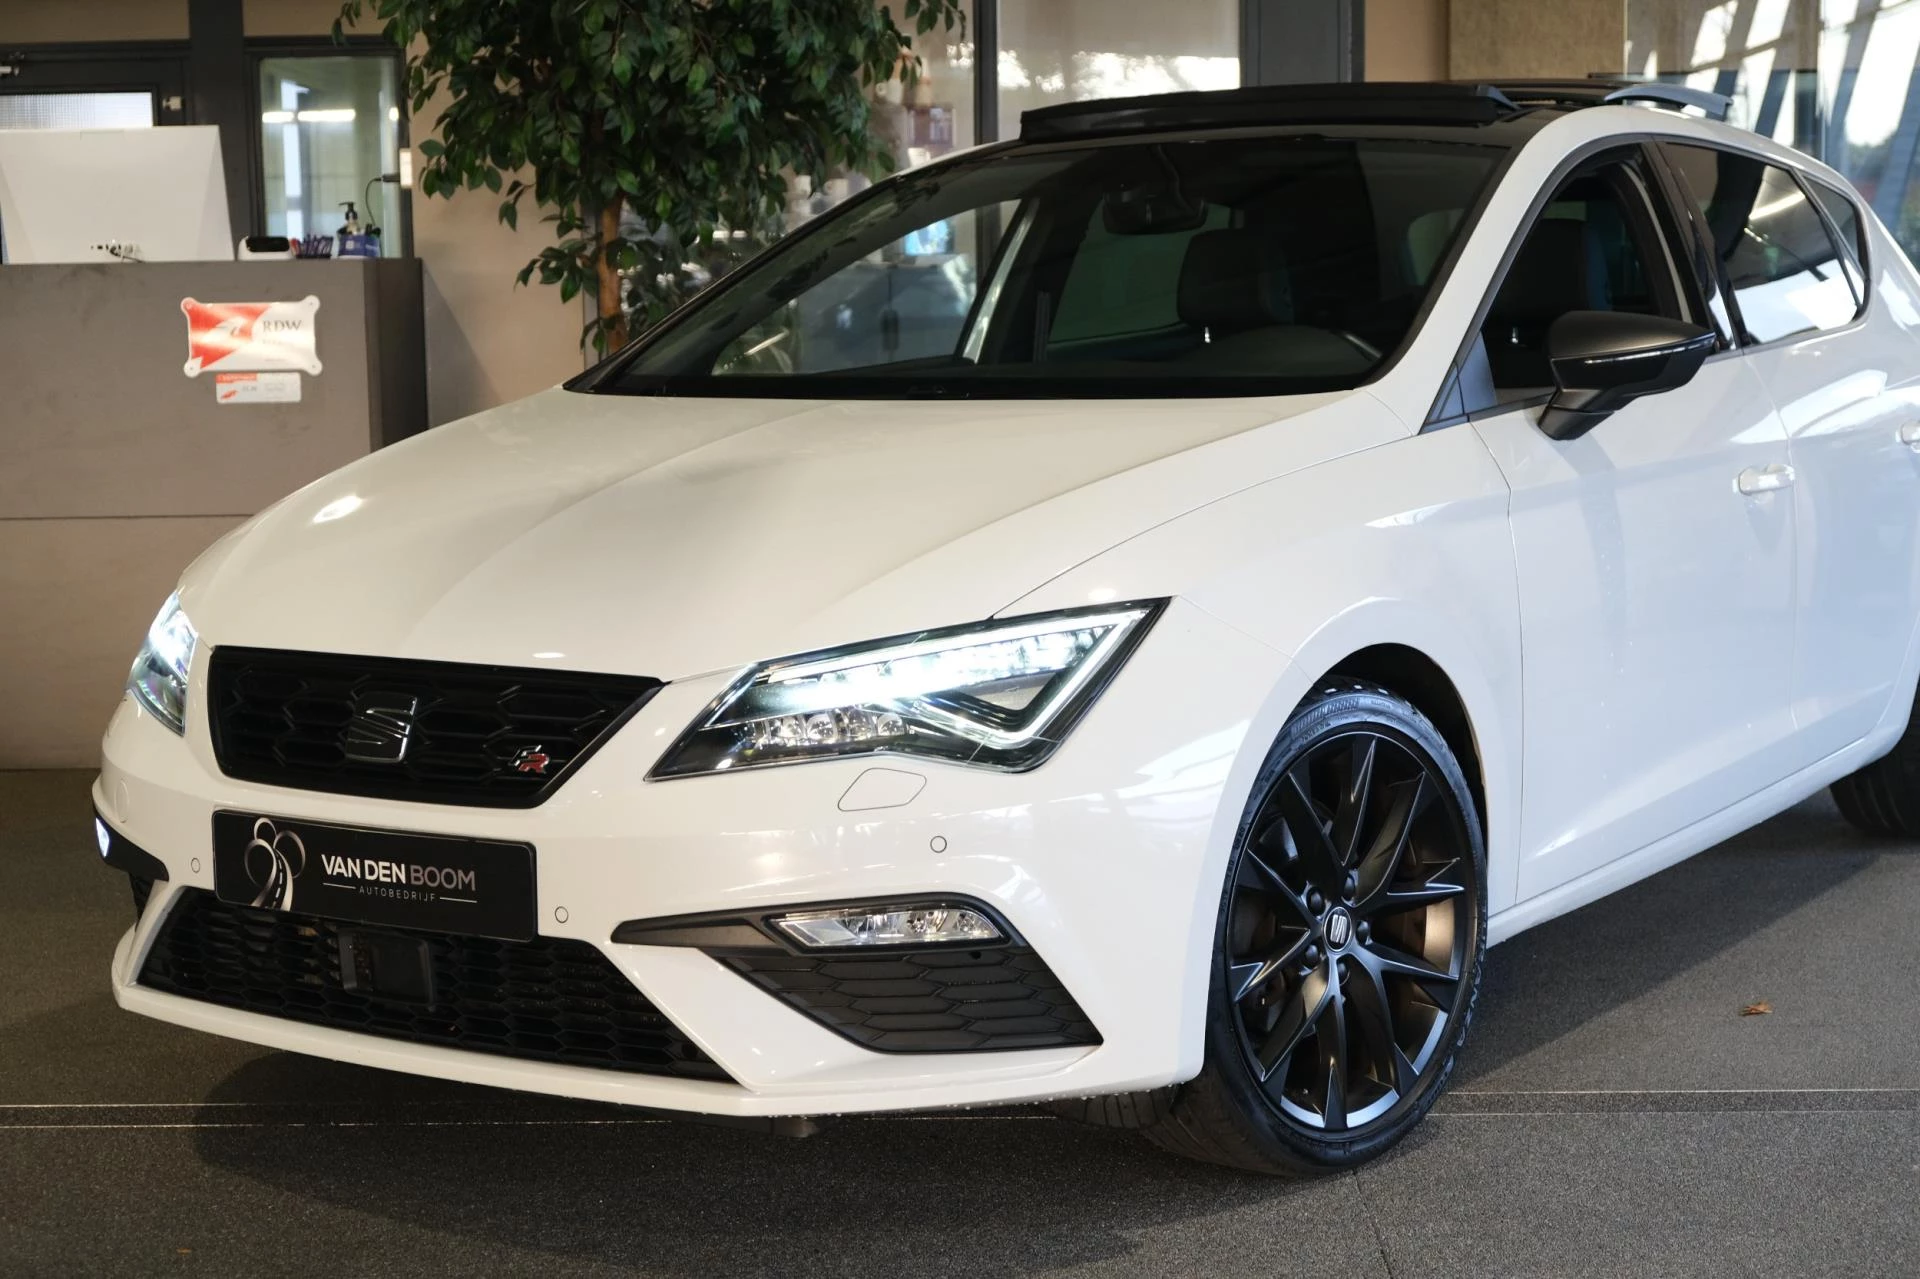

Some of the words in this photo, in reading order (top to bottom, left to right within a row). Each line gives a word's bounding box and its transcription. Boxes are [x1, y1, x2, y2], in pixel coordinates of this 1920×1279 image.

[262, 319, 303, 333] RDW
[321, 854, 361, 879] VAN
[364, 859, 406, 884] DEN
[410, 864, 476, 891] BOOM
[359, 885, 436, 901] AUTOBEDRIJF
